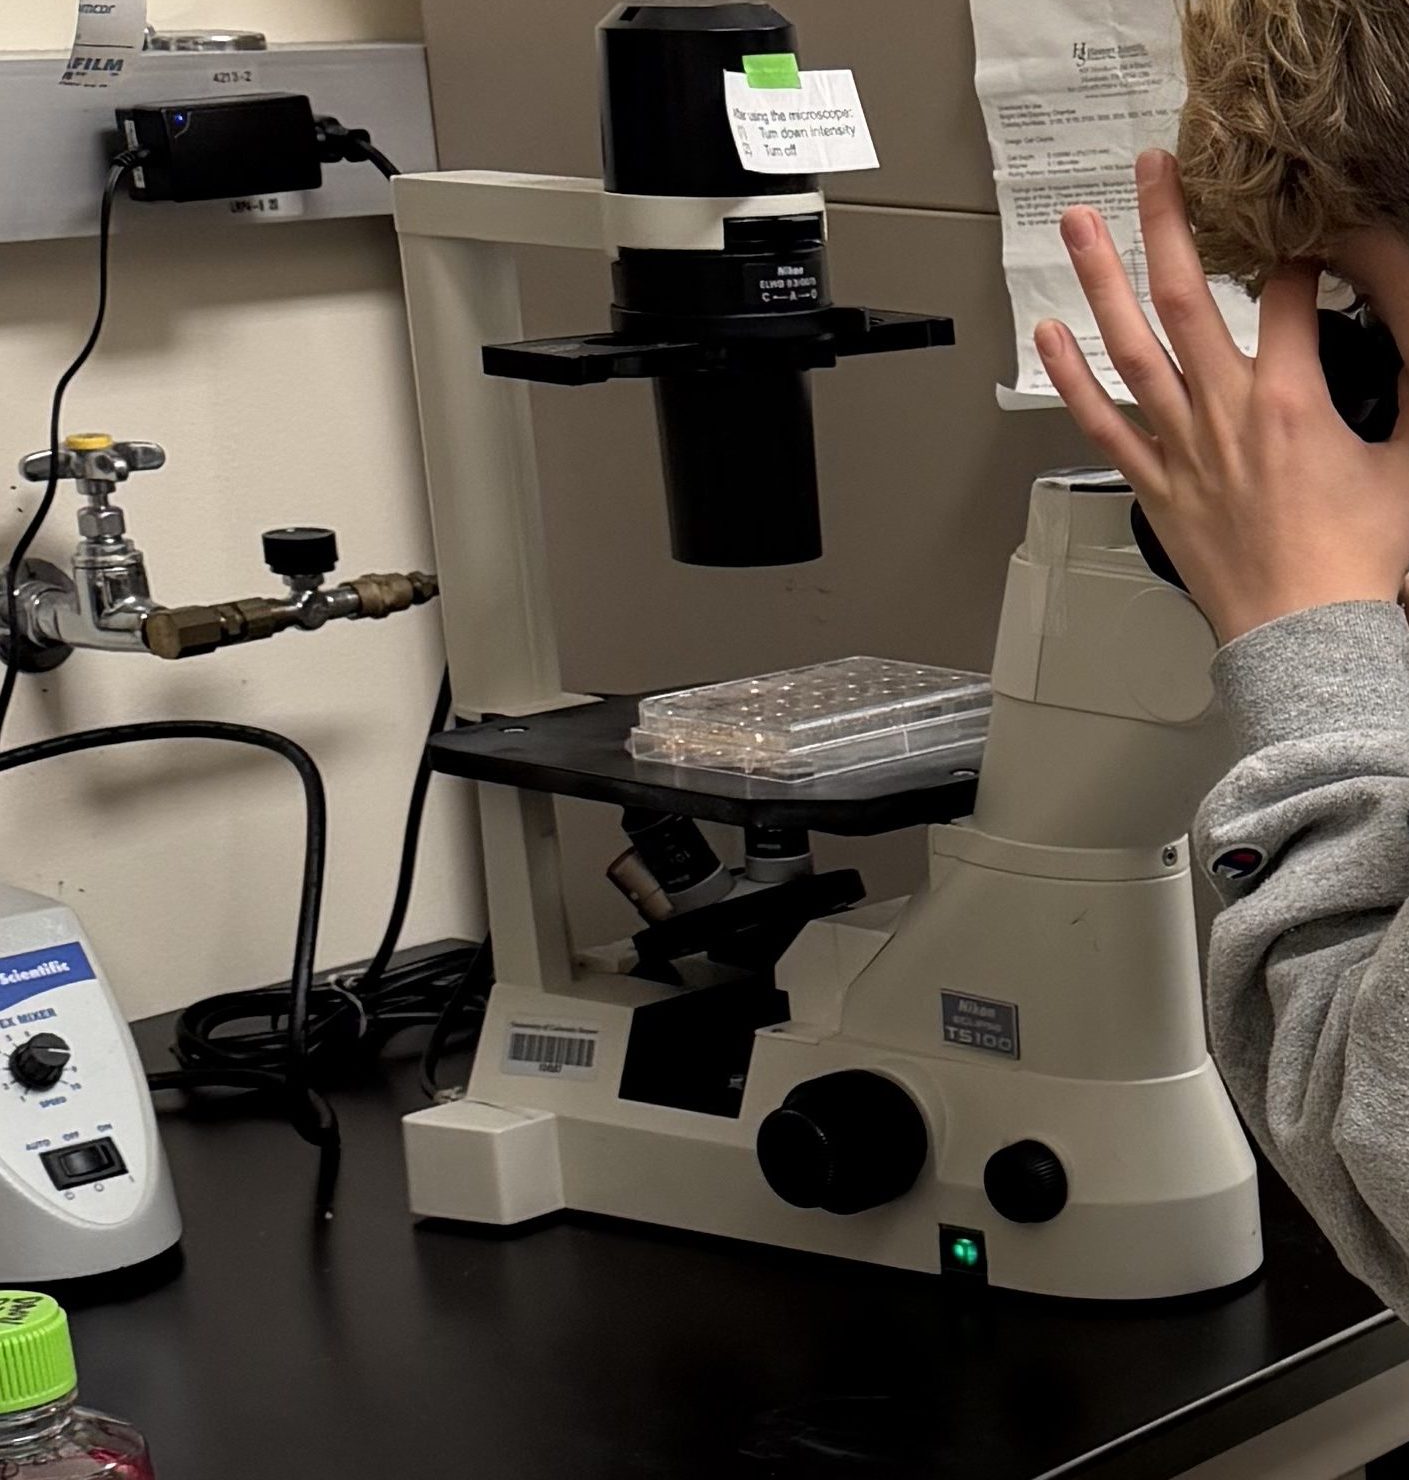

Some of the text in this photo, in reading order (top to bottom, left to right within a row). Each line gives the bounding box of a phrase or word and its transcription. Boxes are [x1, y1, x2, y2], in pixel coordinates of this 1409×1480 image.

[780, 127, 809, 139] down
[811, 125, 856, 138] intensity
[0, 960, 70, 986] Scientific
[17, 1007, 57, 1024] MIXER
[945, 1025, 1012, 1052] TS100
[25, 1139, 51, 1152] AUTO
